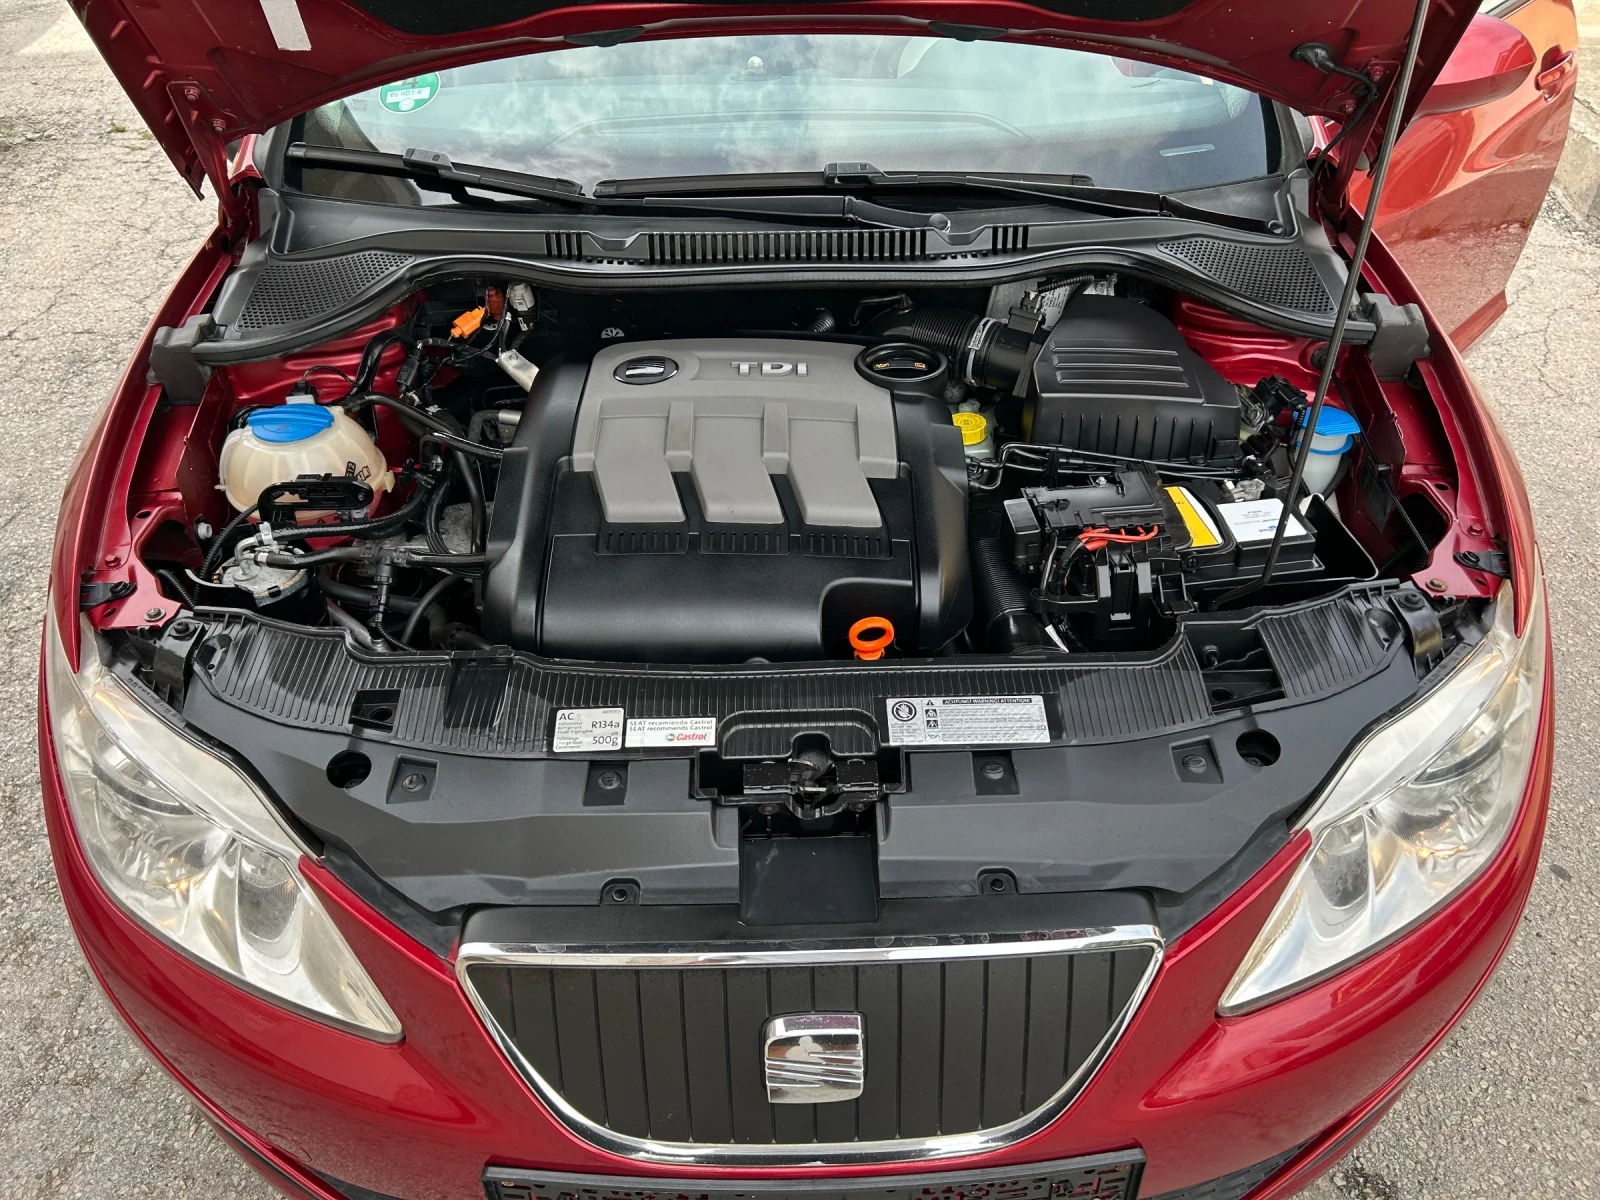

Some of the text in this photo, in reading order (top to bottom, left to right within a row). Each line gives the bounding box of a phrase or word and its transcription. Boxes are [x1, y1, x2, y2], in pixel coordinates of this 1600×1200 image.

[730, 361, 808, 377] TDI
[559, 712, 575, 721] AC
[591, 720, 620, 729] R134a
[592, 735, 619, 747] 500g
[676, 732, 707, 741] Castrol
